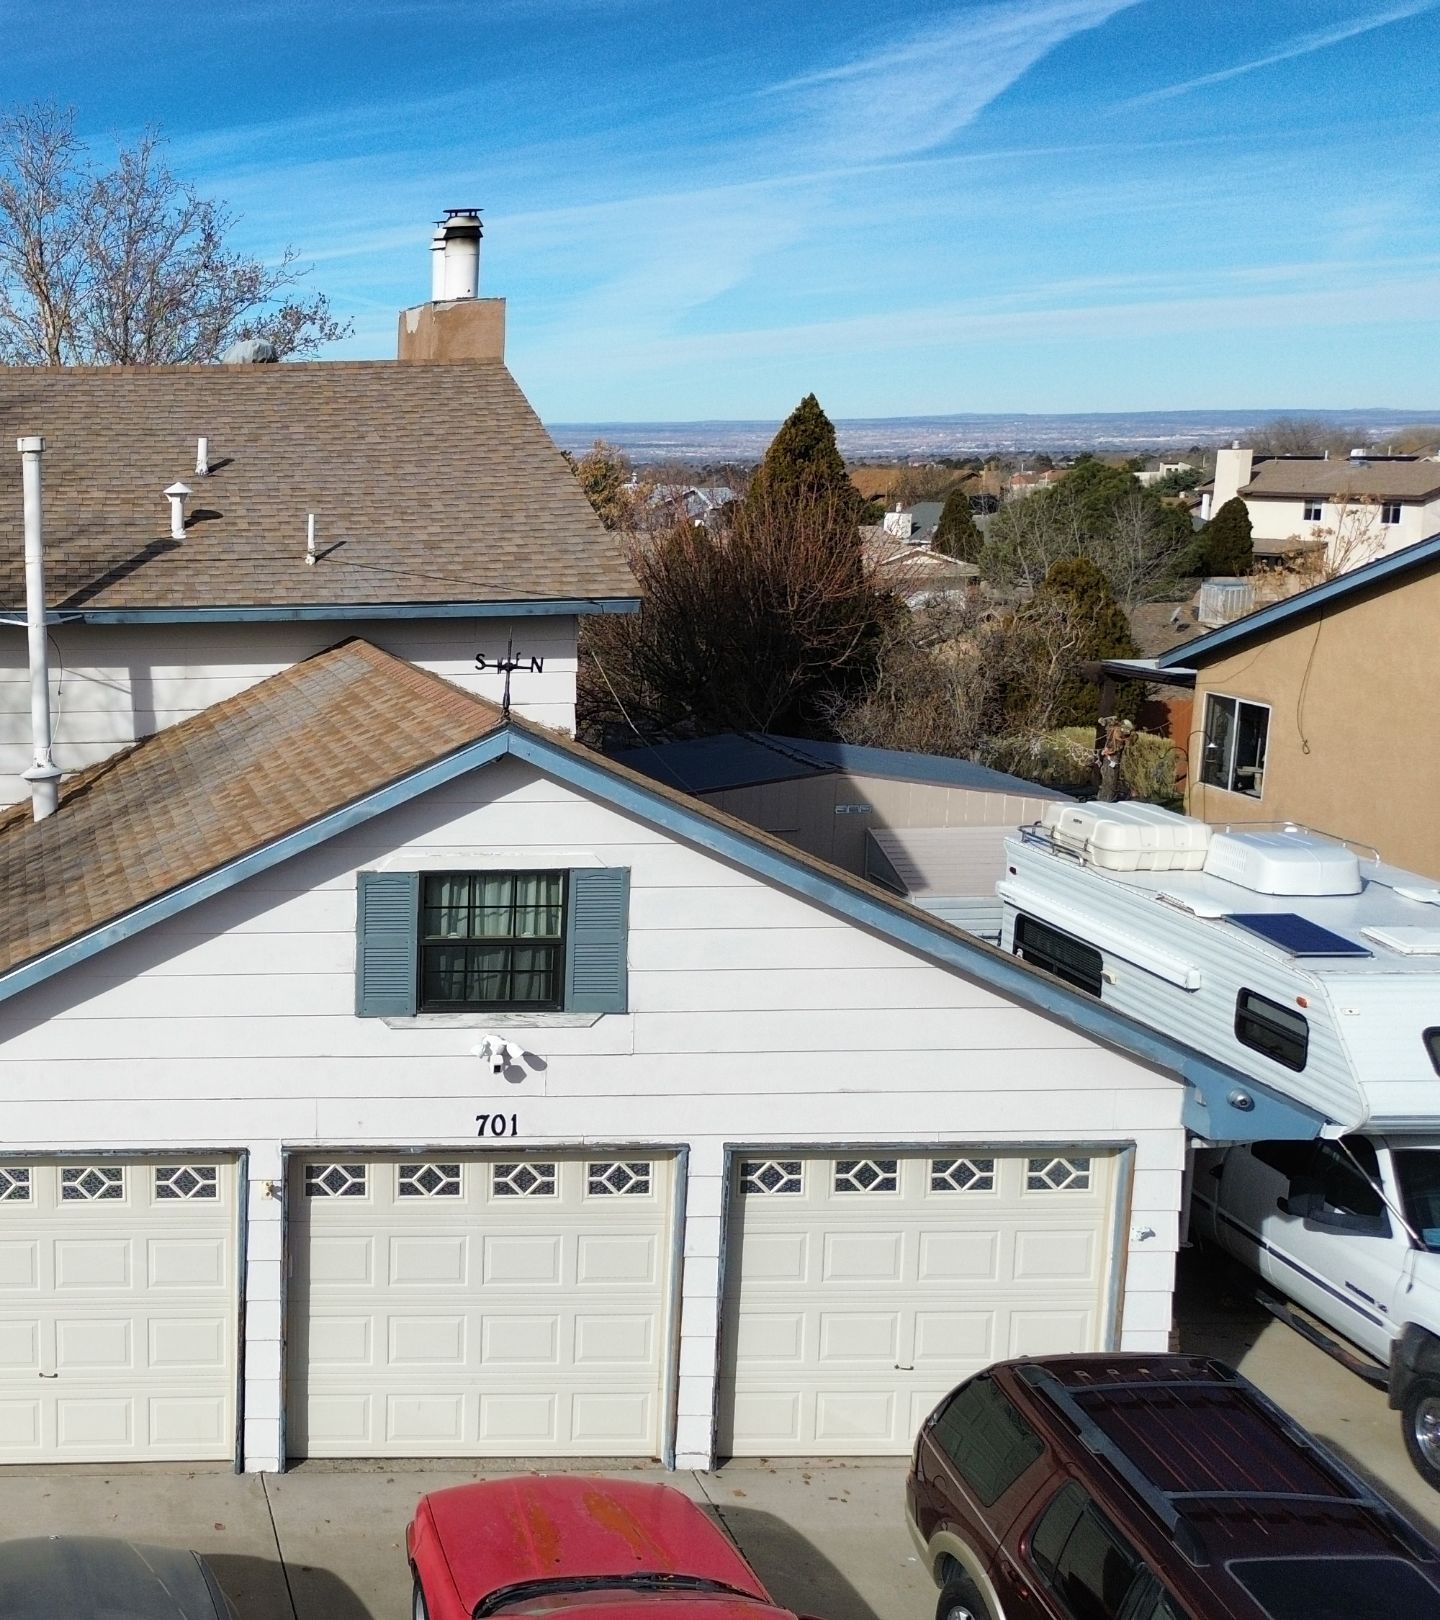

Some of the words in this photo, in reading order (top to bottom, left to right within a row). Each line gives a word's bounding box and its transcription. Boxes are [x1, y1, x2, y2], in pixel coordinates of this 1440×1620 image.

[475, 653, 486, 670] S
[530, 656, 544, 673] N
[475, 1113, 518, 1137] 701
